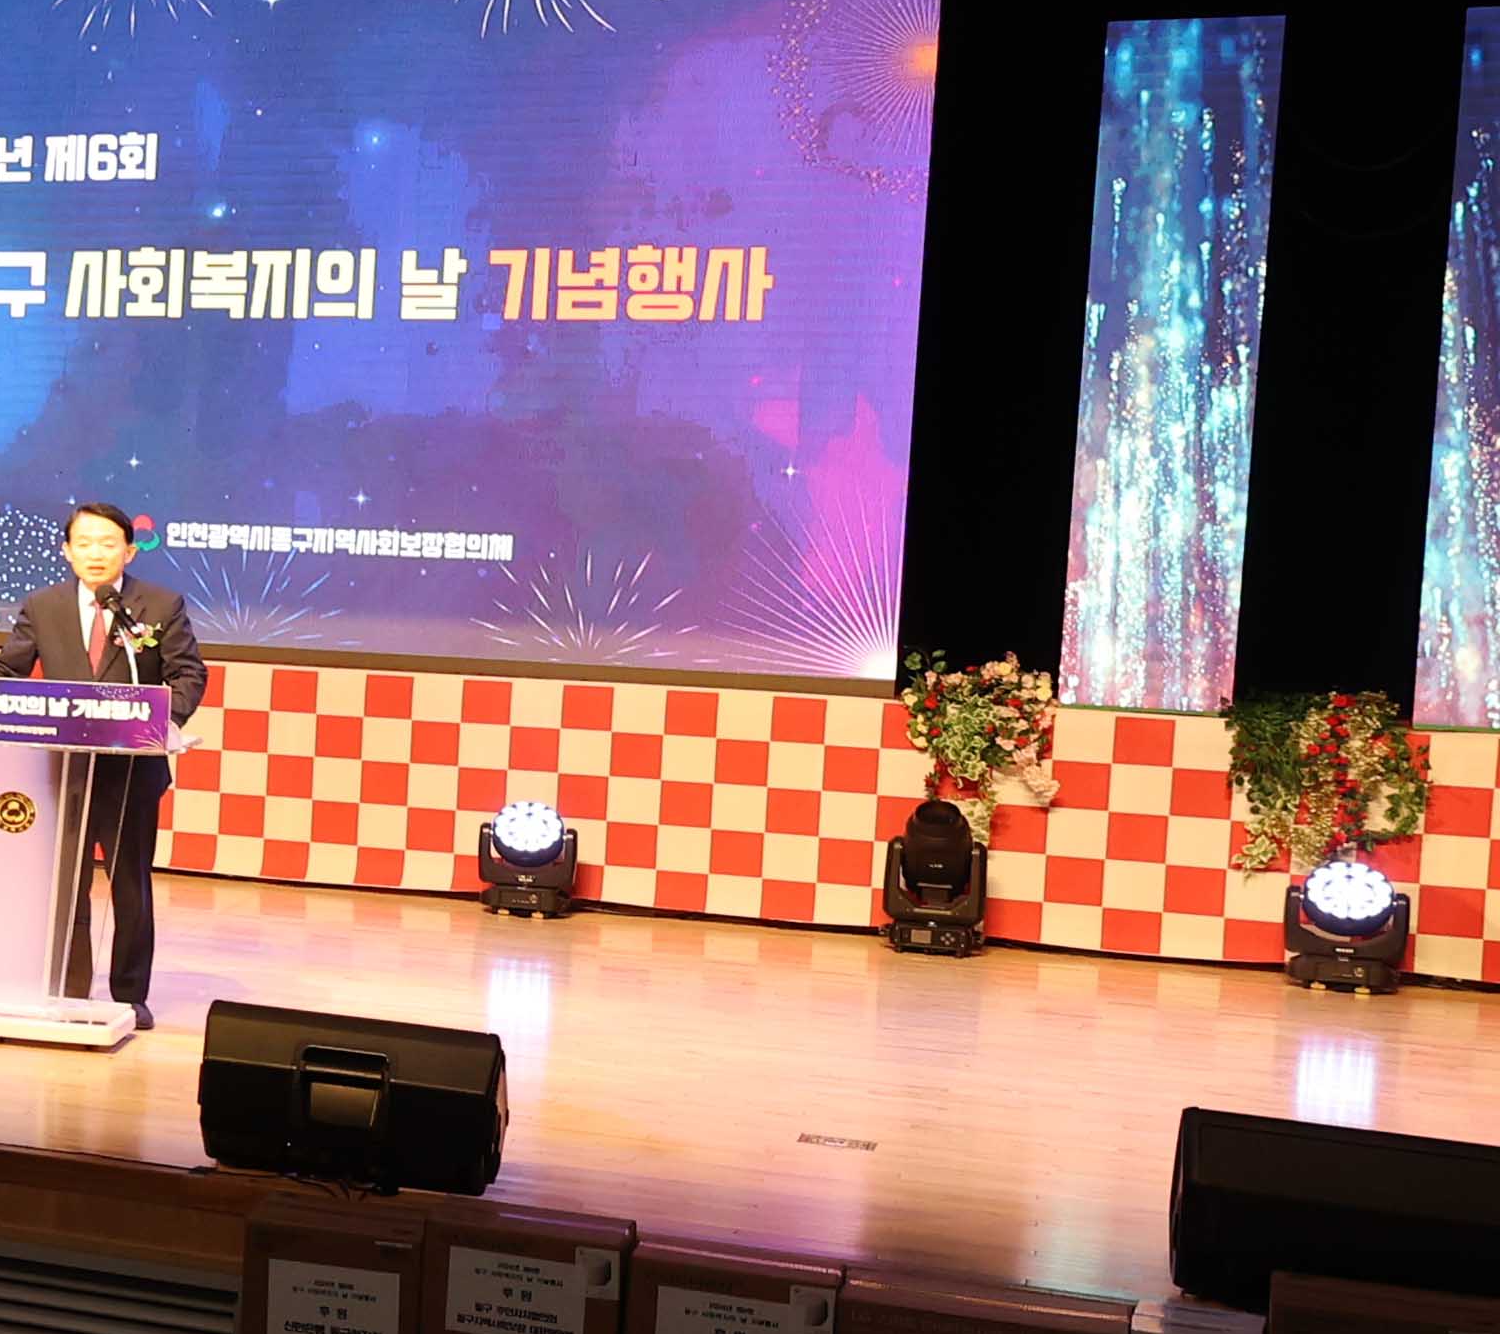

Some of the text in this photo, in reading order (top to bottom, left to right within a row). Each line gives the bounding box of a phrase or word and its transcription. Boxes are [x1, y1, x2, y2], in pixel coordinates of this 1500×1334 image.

[45, 133, 158, 183] 제6회
[64, 245, 376, 323] 사회복지의
[399, 246, 467, 322] 날
[488, 244, 774, 323] 기념행사
[166, 522, 514, 562] 인천광역시동구지역사회보장협의체
